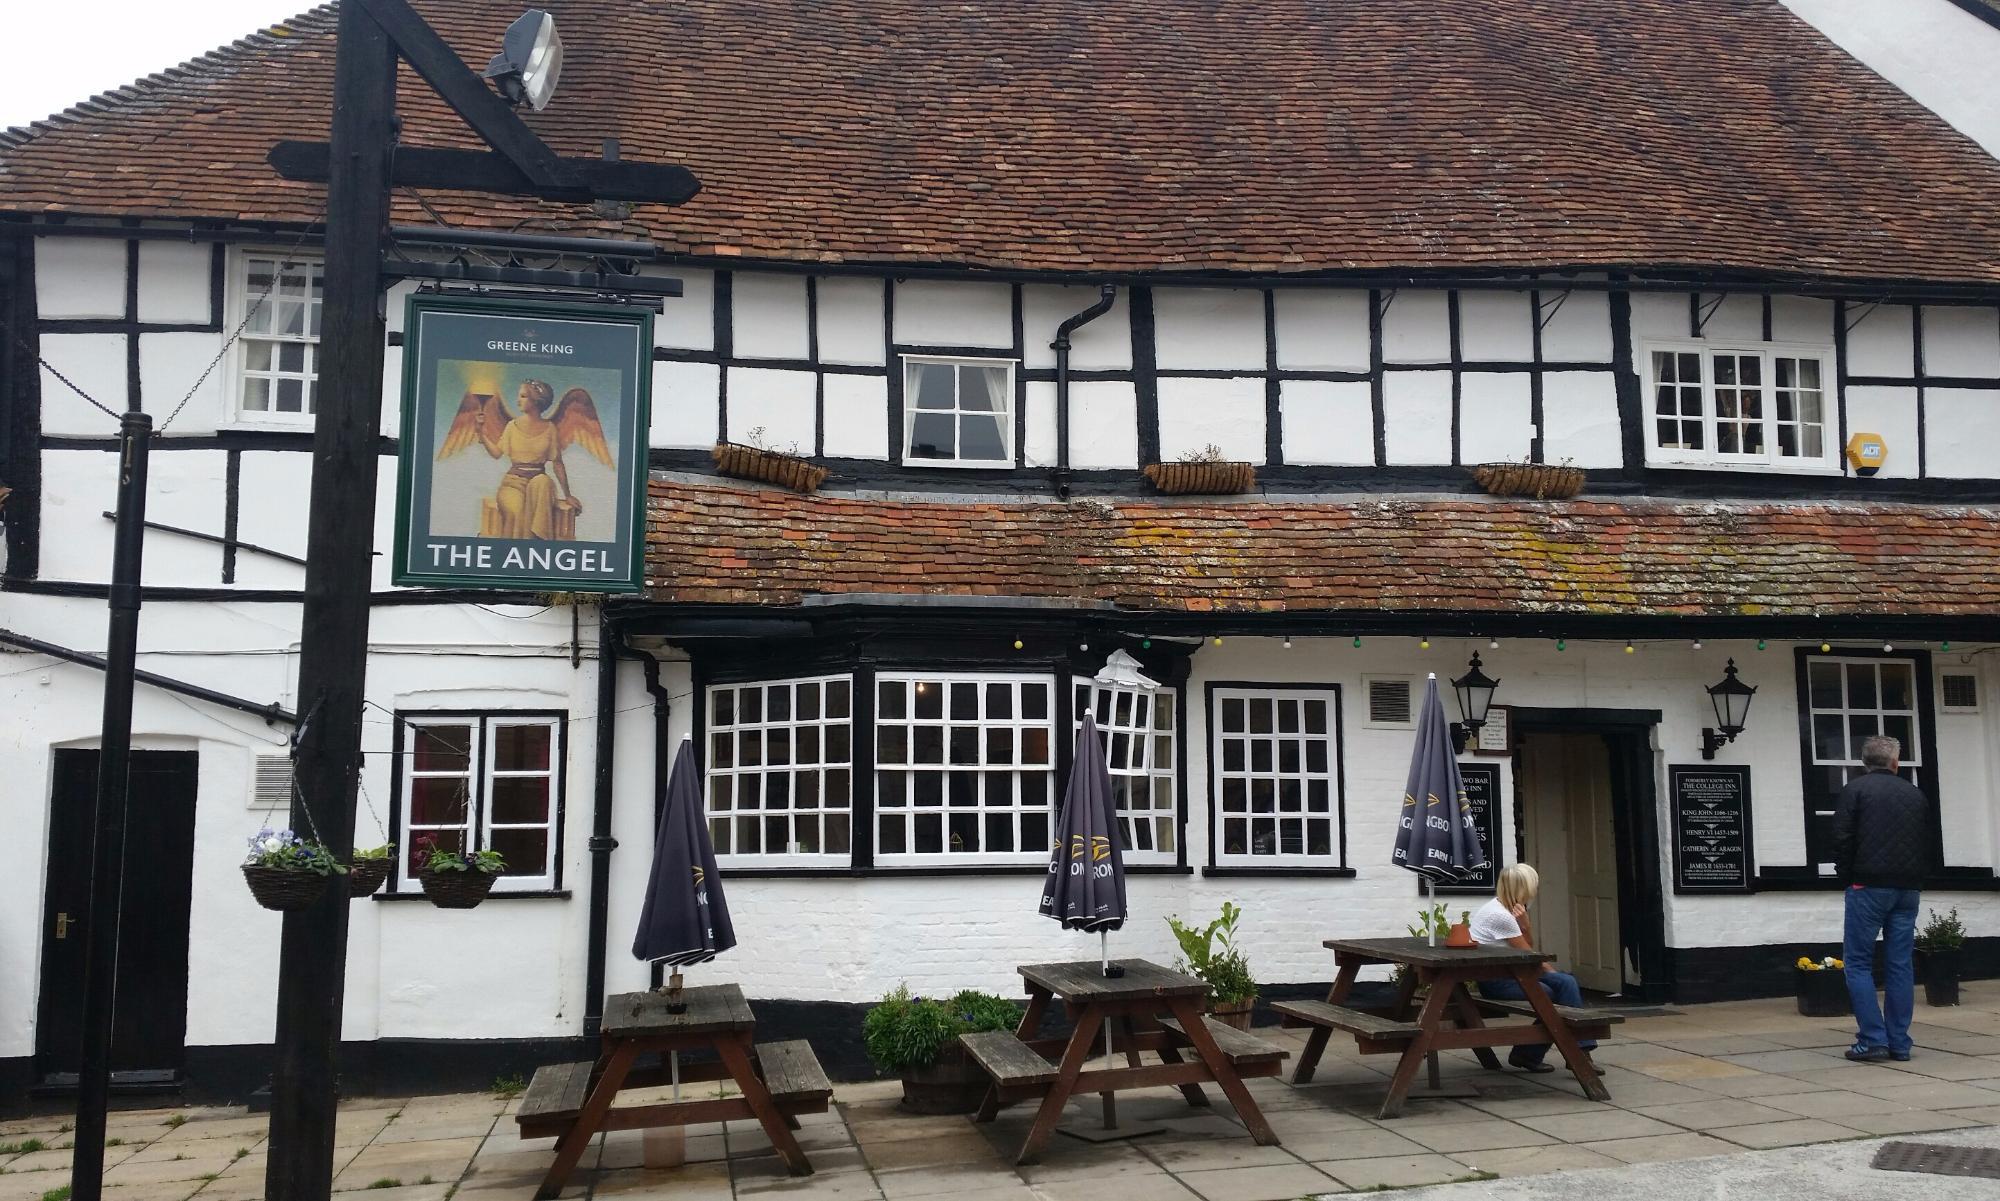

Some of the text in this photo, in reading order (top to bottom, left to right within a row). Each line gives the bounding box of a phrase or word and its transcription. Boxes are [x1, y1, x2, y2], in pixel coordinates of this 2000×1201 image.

[487, 340, 573, 354] GREENE KING
[1863, 446, 1880, 456] ADT
[427, 544, 614, 573] THE ANGEL
